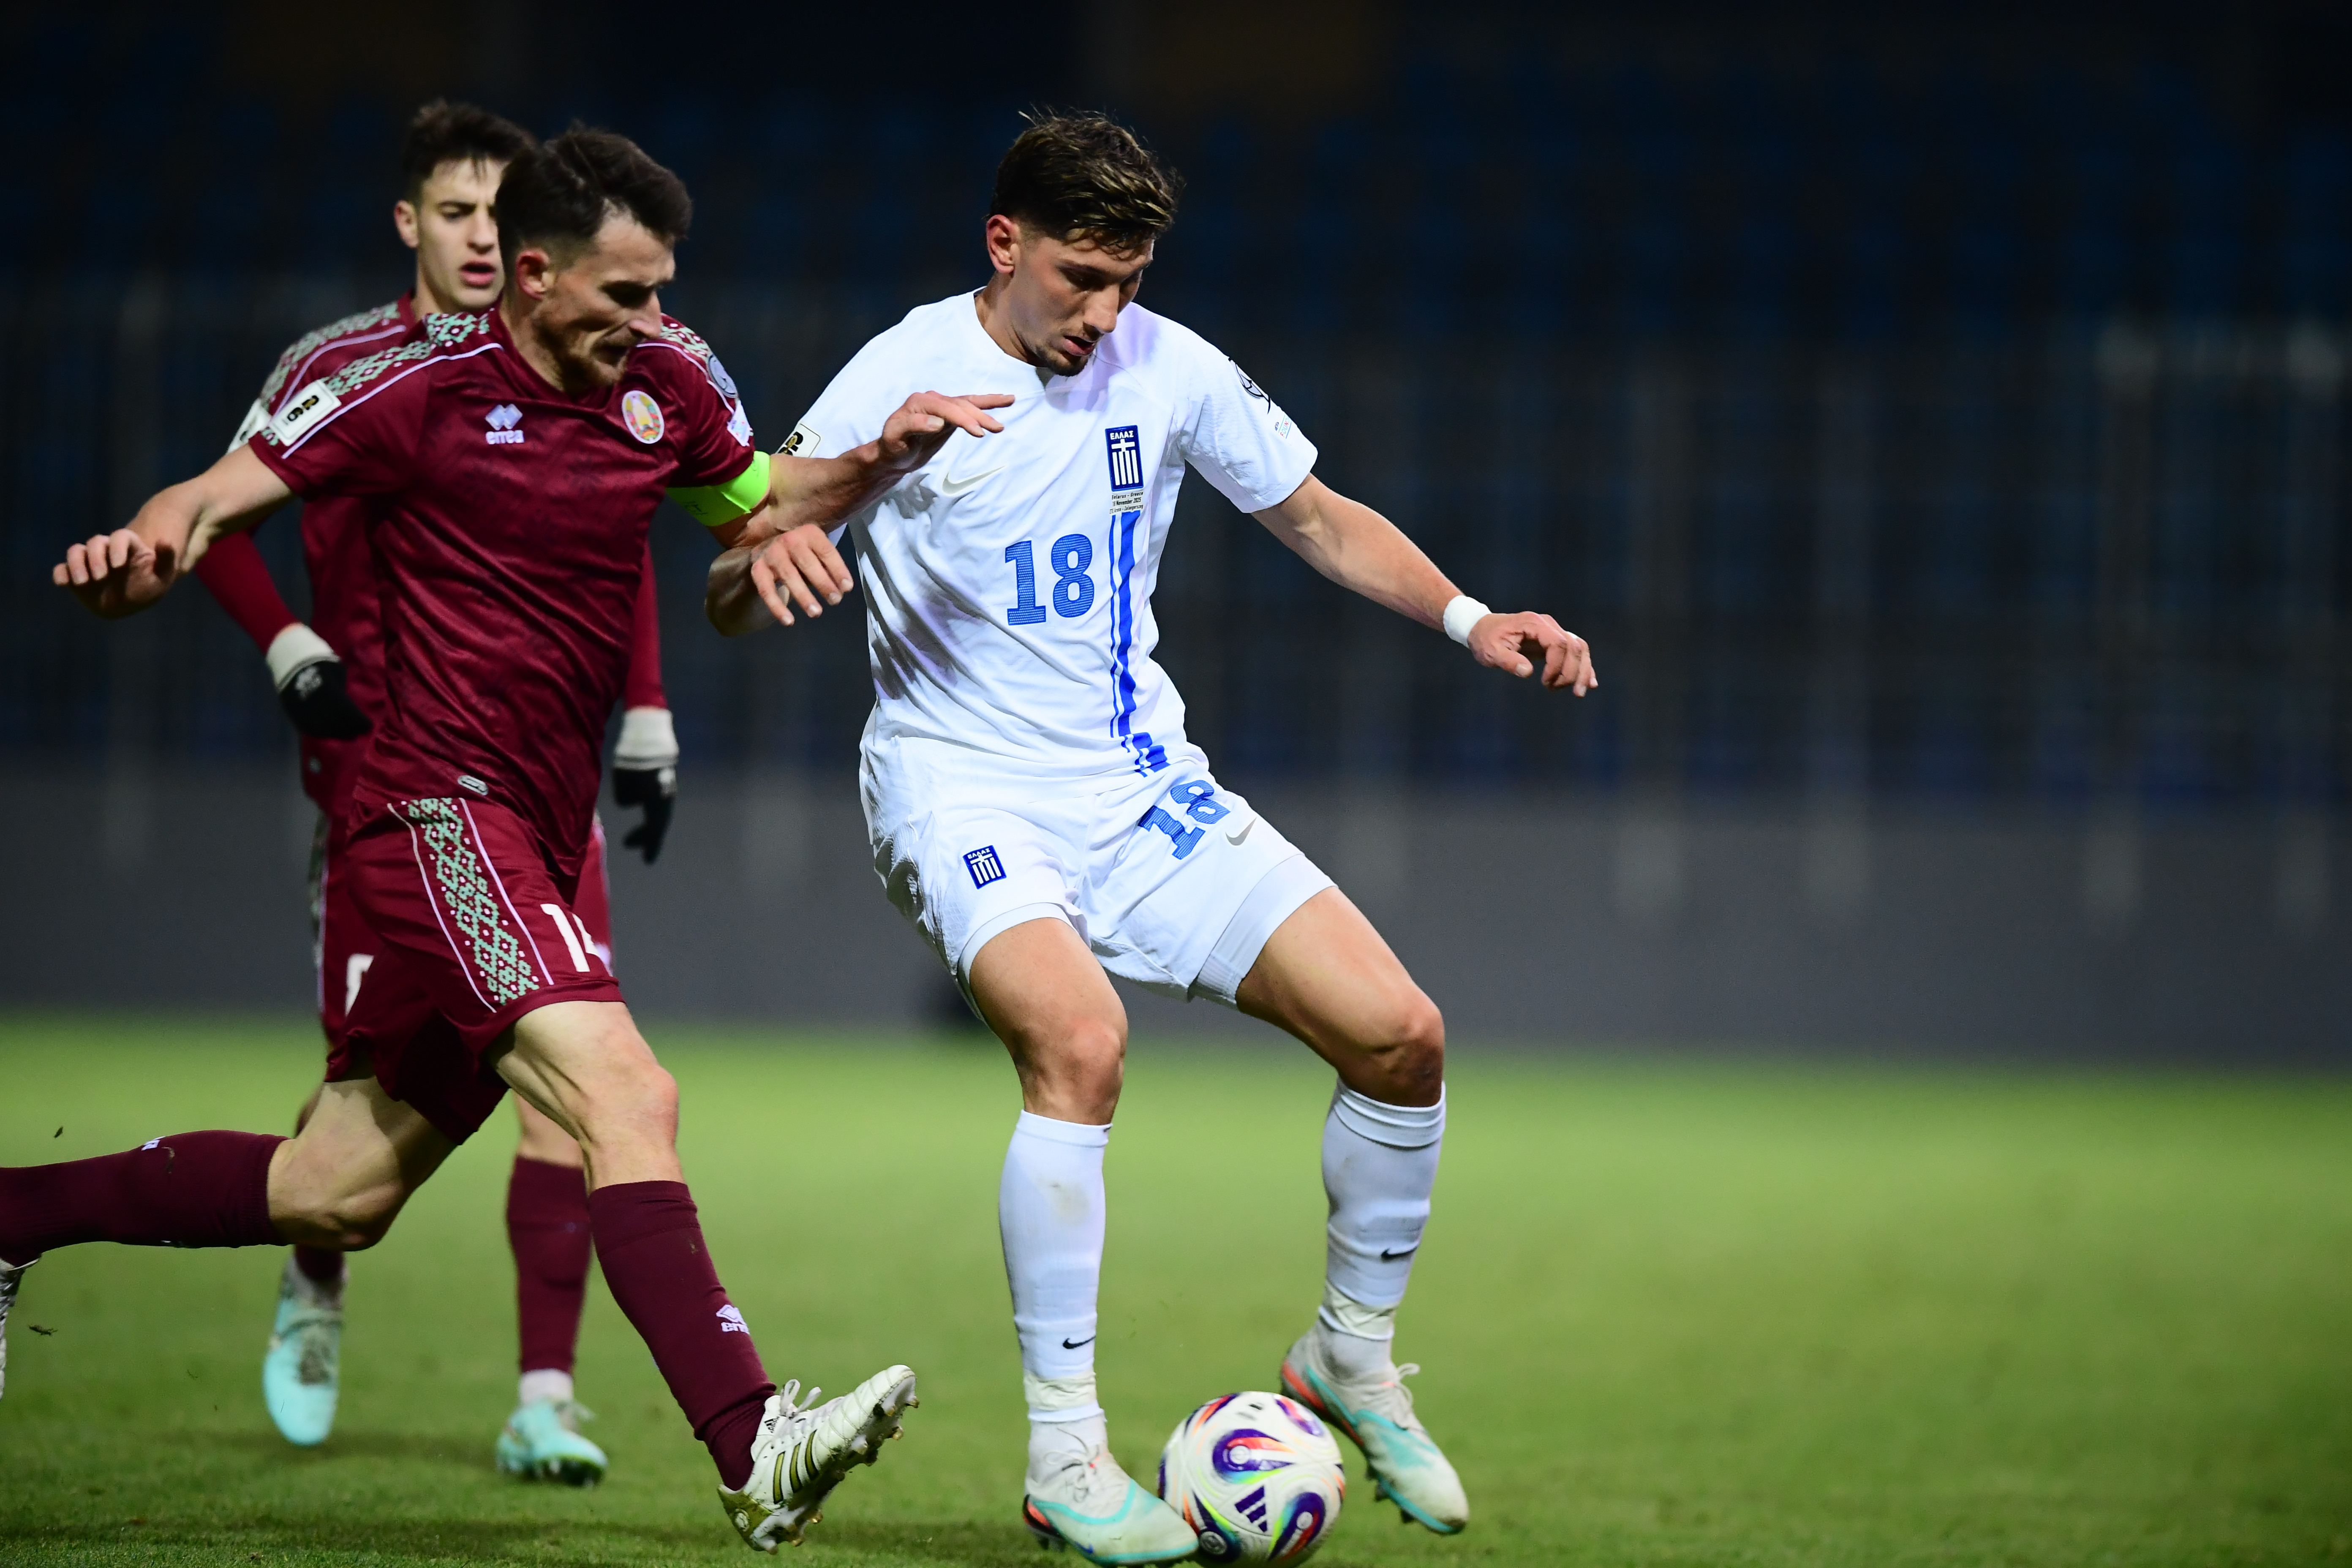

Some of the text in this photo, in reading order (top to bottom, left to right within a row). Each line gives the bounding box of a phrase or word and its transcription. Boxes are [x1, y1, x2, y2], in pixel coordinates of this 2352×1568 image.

[1110, 430, 1134, 440] ΕΛΛΑΣ
[1005, 534, 1094, 626] 18
[1138, 780, 1231, 860] 18
[967, 848, 991, 859] ΕΛΛΑΣ
